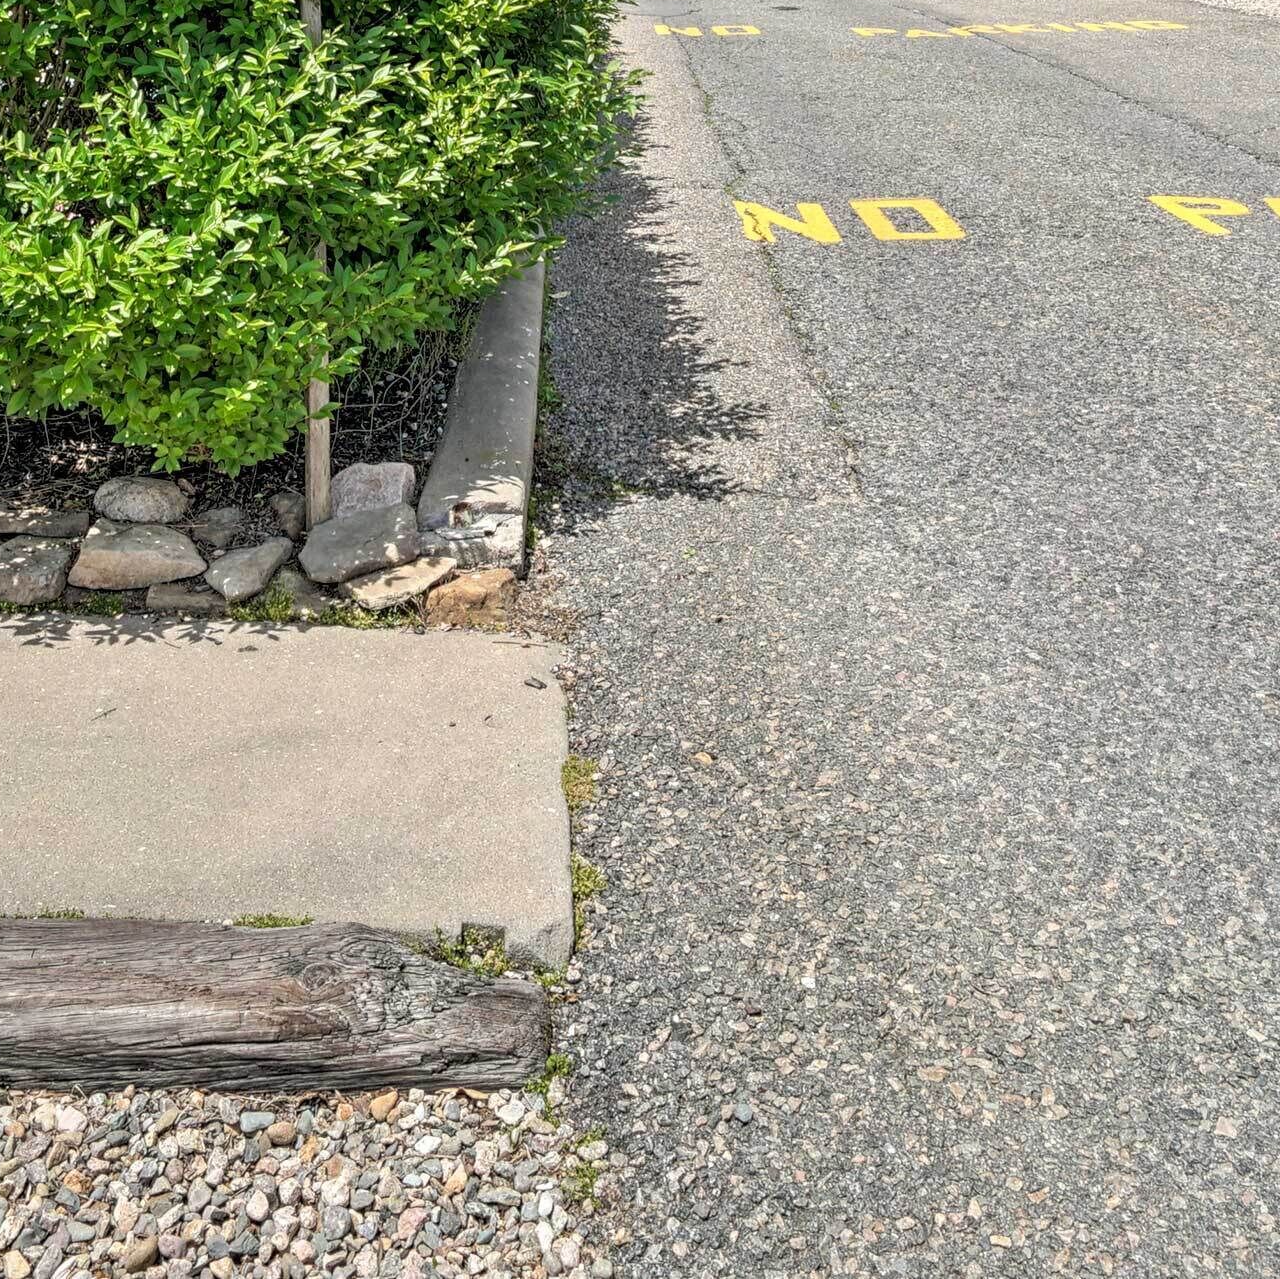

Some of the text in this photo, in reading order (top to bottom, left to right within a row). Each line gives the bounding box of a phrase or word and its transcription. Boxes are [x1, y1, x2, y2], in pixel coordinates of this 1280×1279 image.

[654, 21, 1188, 38] NO PARKING
[732, 197, 967, 244] NO
